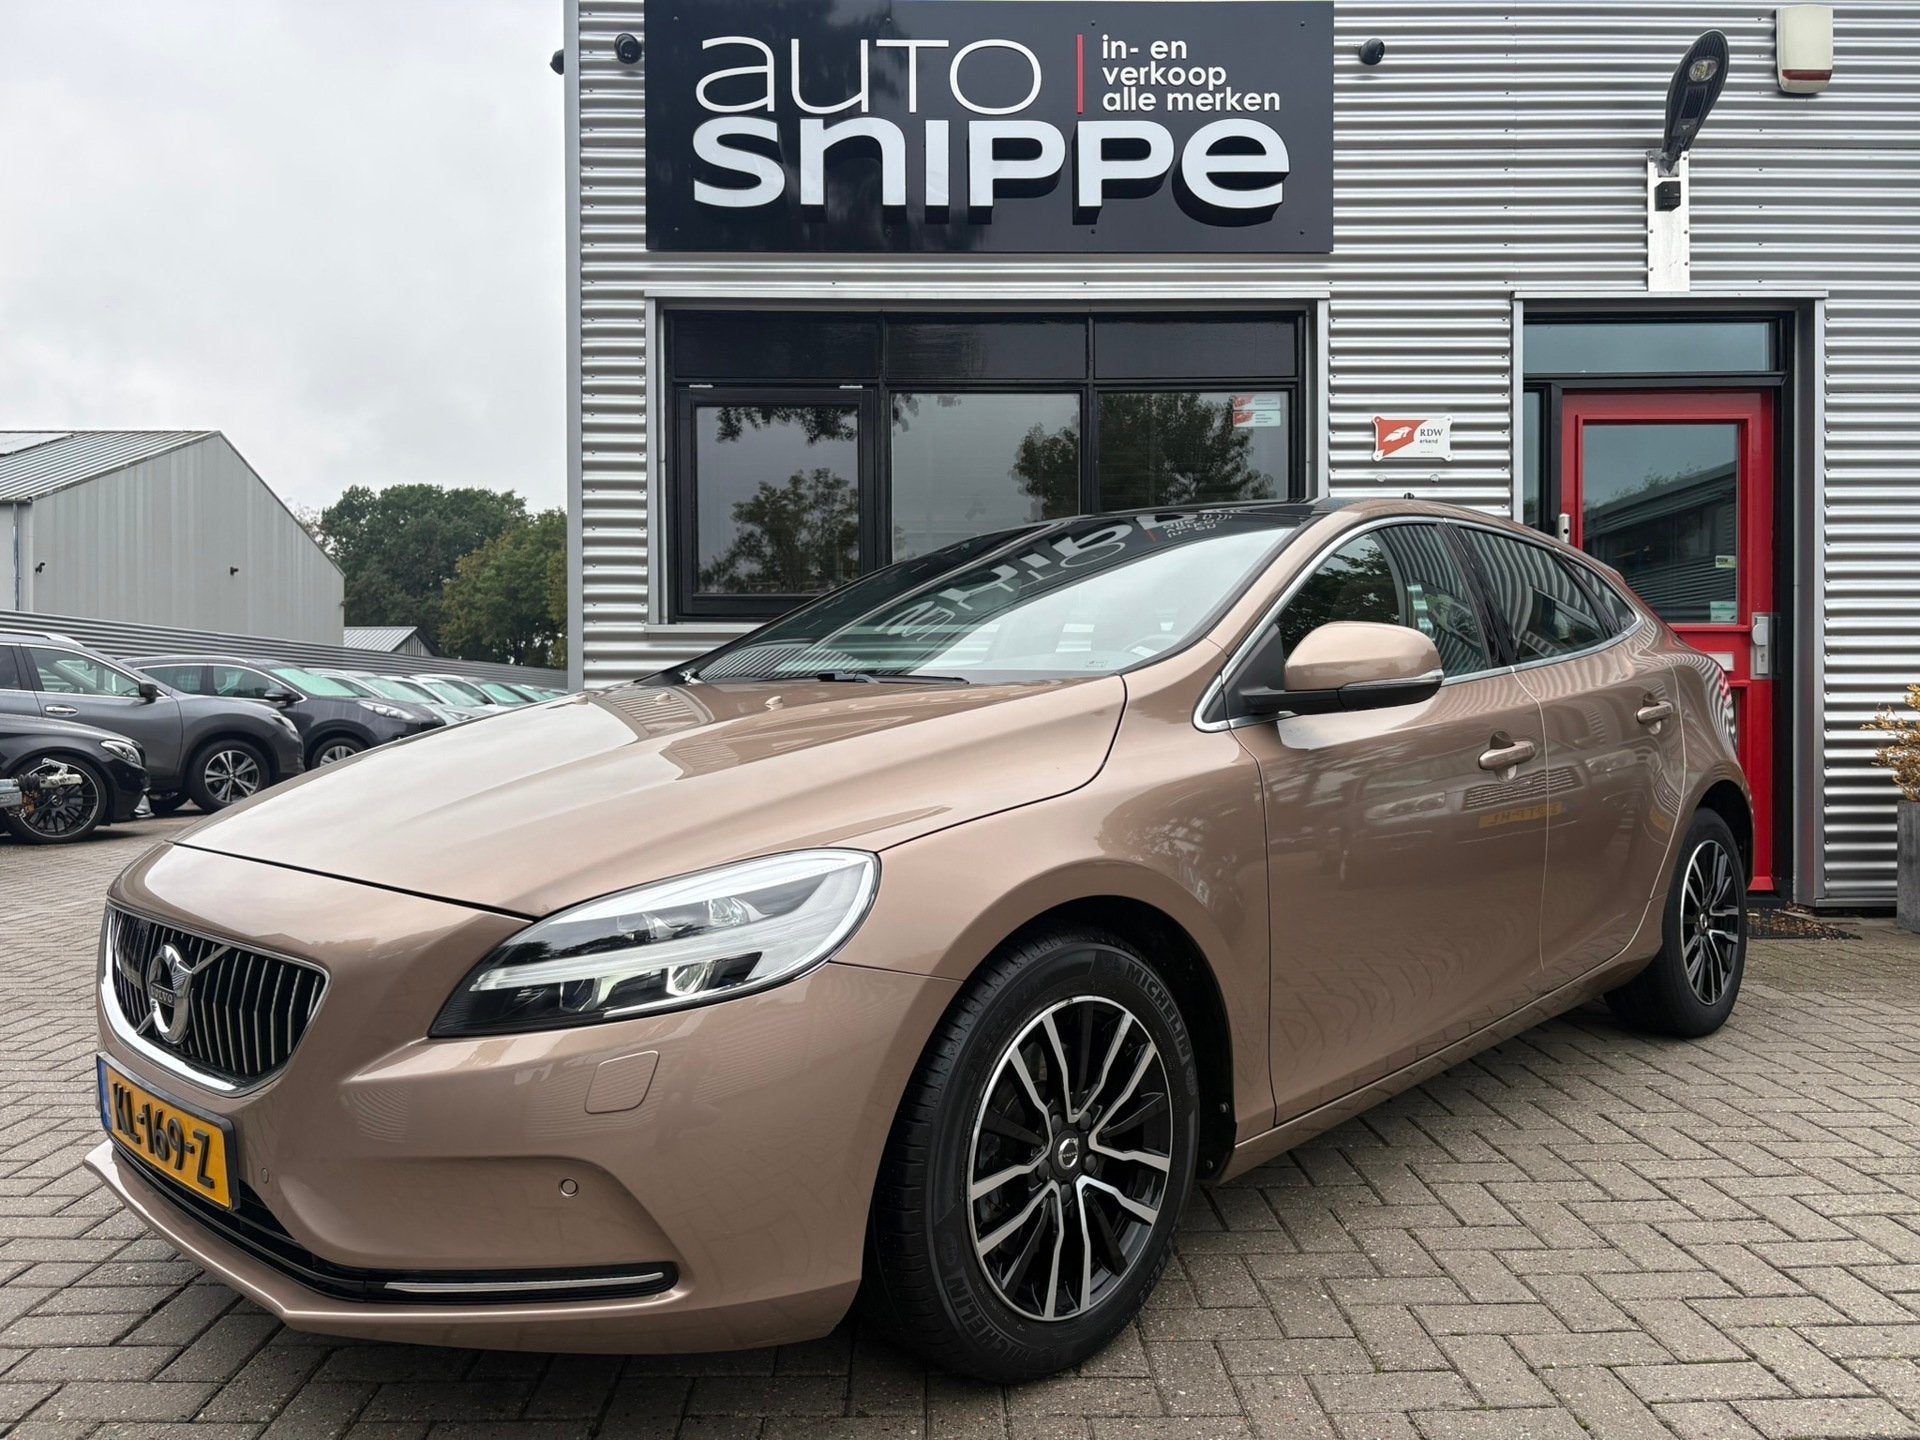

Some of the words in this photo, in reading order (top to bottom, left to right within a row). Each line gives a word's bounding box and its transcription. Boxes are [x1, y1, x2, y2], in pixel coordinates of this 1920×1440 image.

[1102, 34, 1139, 59] in-
[1150, 40, 1187, 59] en
[1102, 61, 1227, 91] verkoop
[1102, 87, 1157, 111] alle
[1167, 87, 1280, 111] merken
[1420, 428, 1444, 437] RDW
[150, 985, 173, 1003] VOLVO
[1126, 963, 1191, 1062] MICHELIN
[112, 1082, 216, 1189] KL-169-Z
[946, 1275, 1032, 1362] MICHELIN
